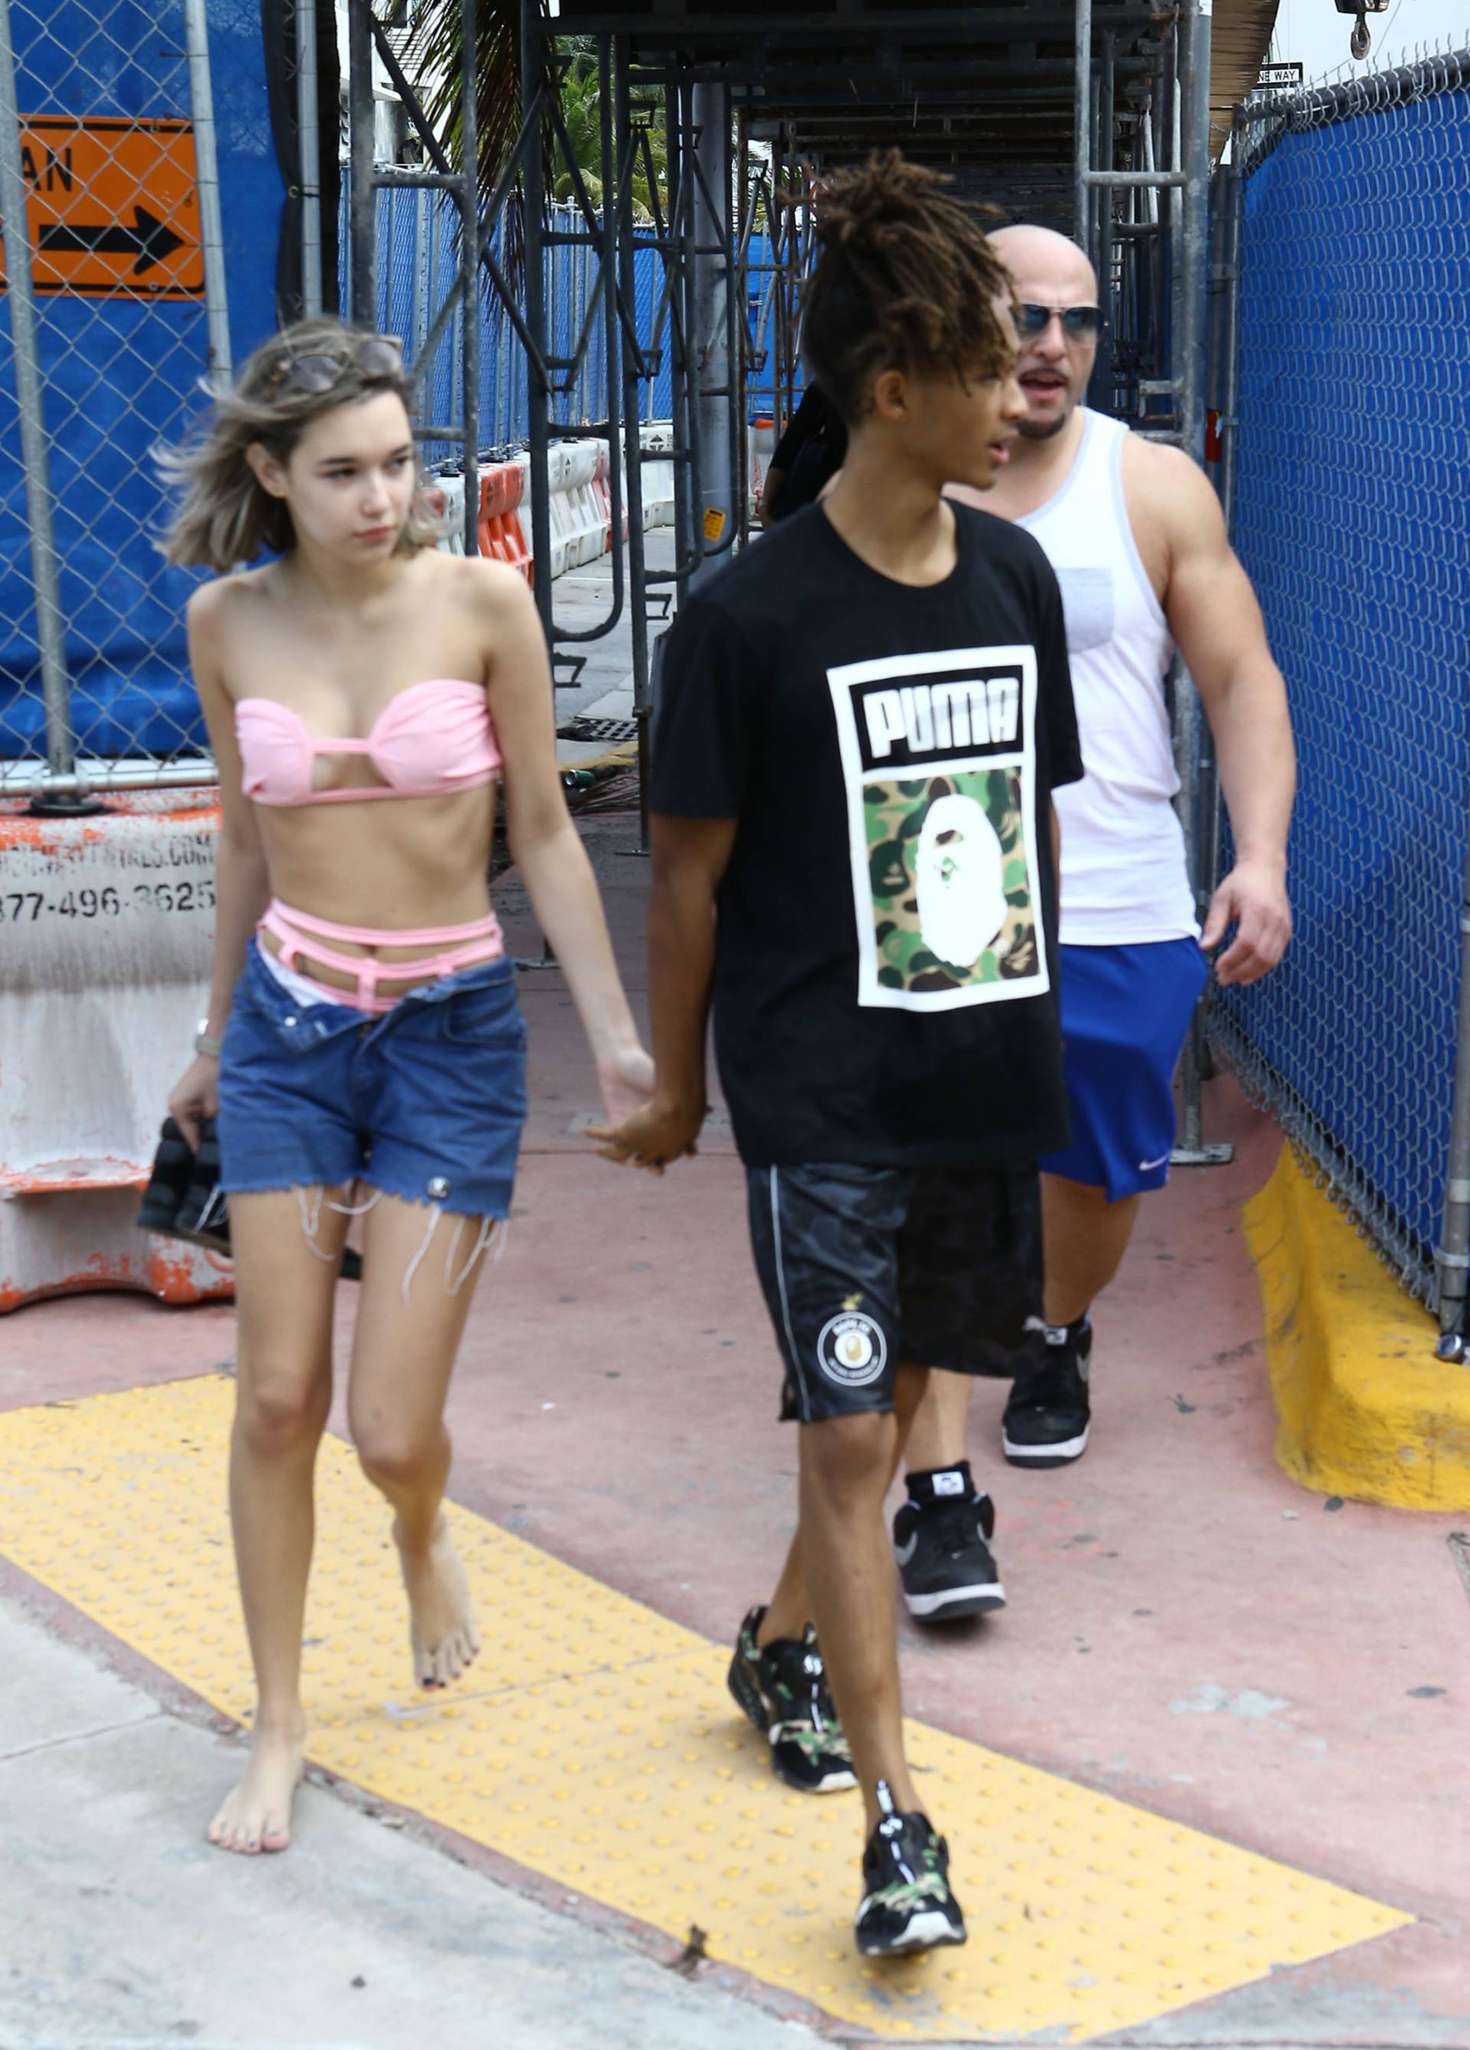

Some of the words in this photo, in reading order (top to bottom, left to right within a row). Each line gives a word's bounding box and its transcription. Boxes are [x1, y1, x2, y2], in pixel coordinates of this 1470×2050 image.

[1274, 70, 1296, 81] WAY
[863, 677, 1020, 759] PUMA
[0, 881, 216, 923] 77-496-3625
